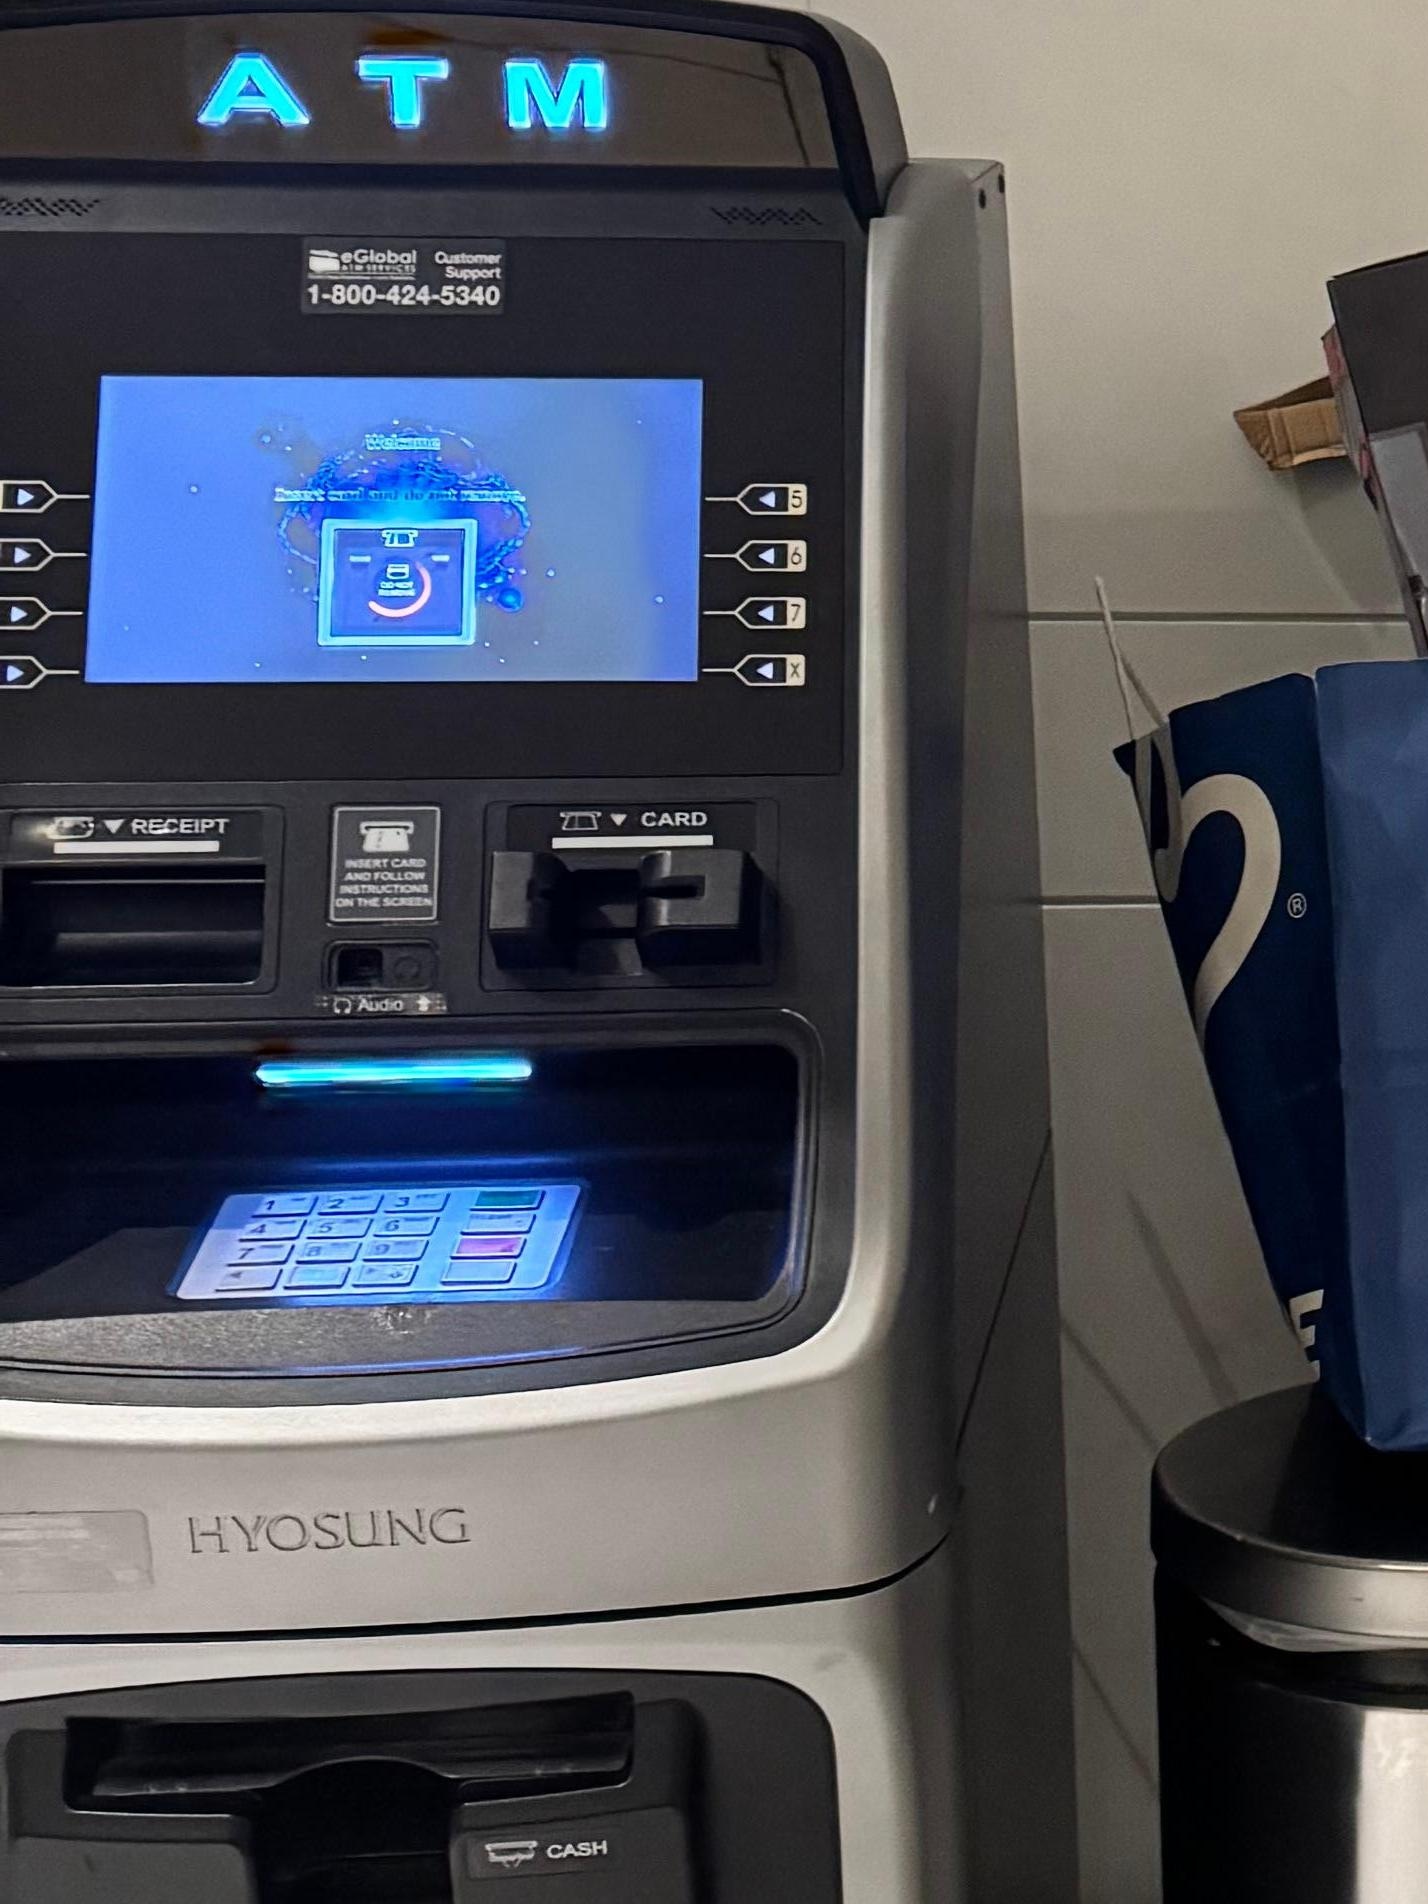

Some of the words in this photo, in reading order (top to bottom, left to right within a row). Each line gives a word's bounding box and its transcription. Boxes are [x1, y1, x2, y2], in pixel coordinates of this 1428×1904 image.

[197, 52, 607, 129] ATM
[340, 249, 417, 264] eGlobal
[434, 251, 501, 264] Customer
[445, 266, 501, 281] Support
[307, 284, 500, 305] 1-800-424-5340
[791, 490, 803, 508] 5
[791, 547, 802, 565] 6
[791, 604, 801, 622] 7
[131, 818, 229, 834] RECEIPT
[641, 812, 707, 827] CARD
[345, 859, 388, 869] INSERT
[391, 858, 427, 868] CARD
[344, 872, 371, 881] AND
[374, 872, 425, 881] FOLLOW
[339, 884, 429, 894] INSTRUCTIONS
[335, 898, 354, 907] ON
[357, 898, 381, 907] THE
[383, 897, 432, 907] SCREEN
[357, 997, 404, 1012] Audio
[188, 1508, 472, 1553] HYOSUNG
[547, 1840, 608, 1858] CASH
